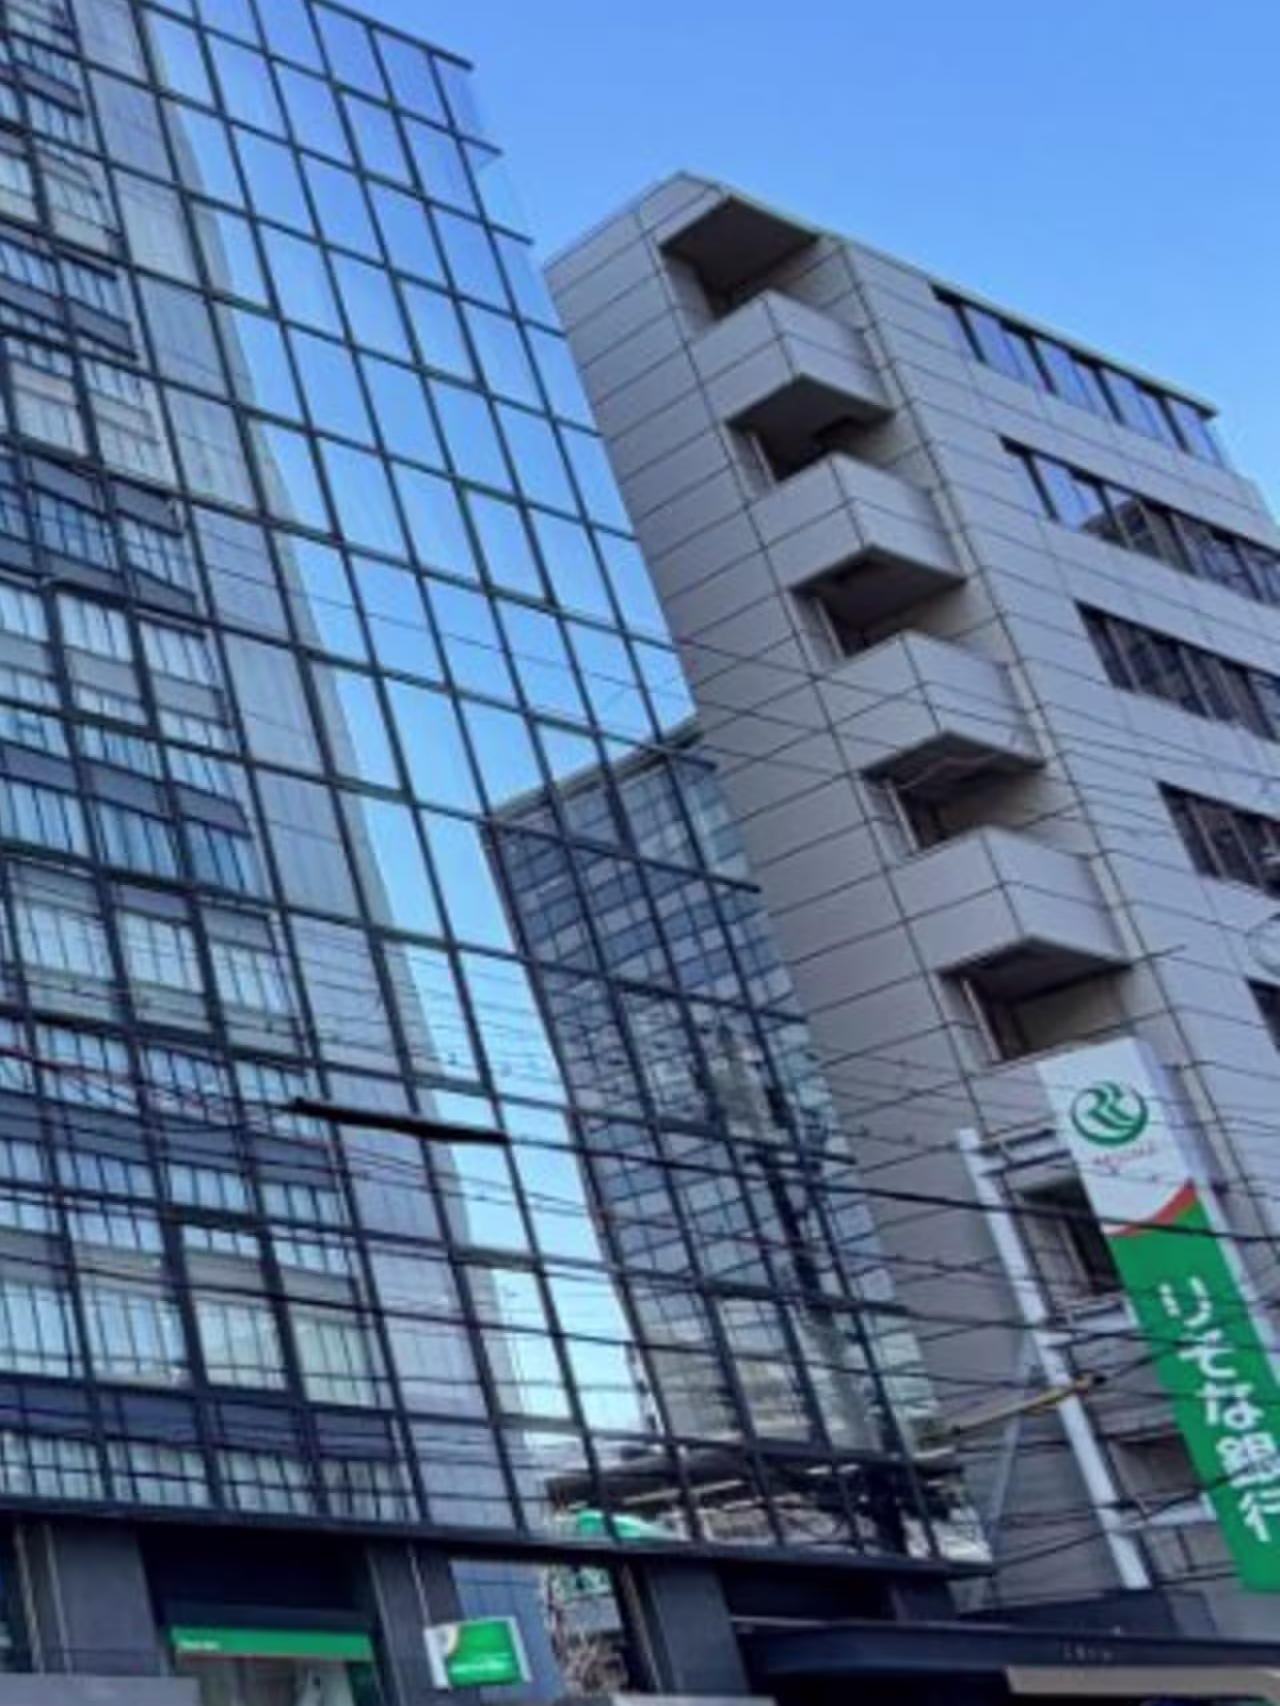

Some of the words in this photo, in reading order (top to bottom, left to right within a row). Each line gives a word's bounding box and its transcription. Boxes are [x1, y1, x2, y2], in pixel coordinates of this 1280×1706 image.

[1158, 1275, 1280, 1543] りそな銀行
